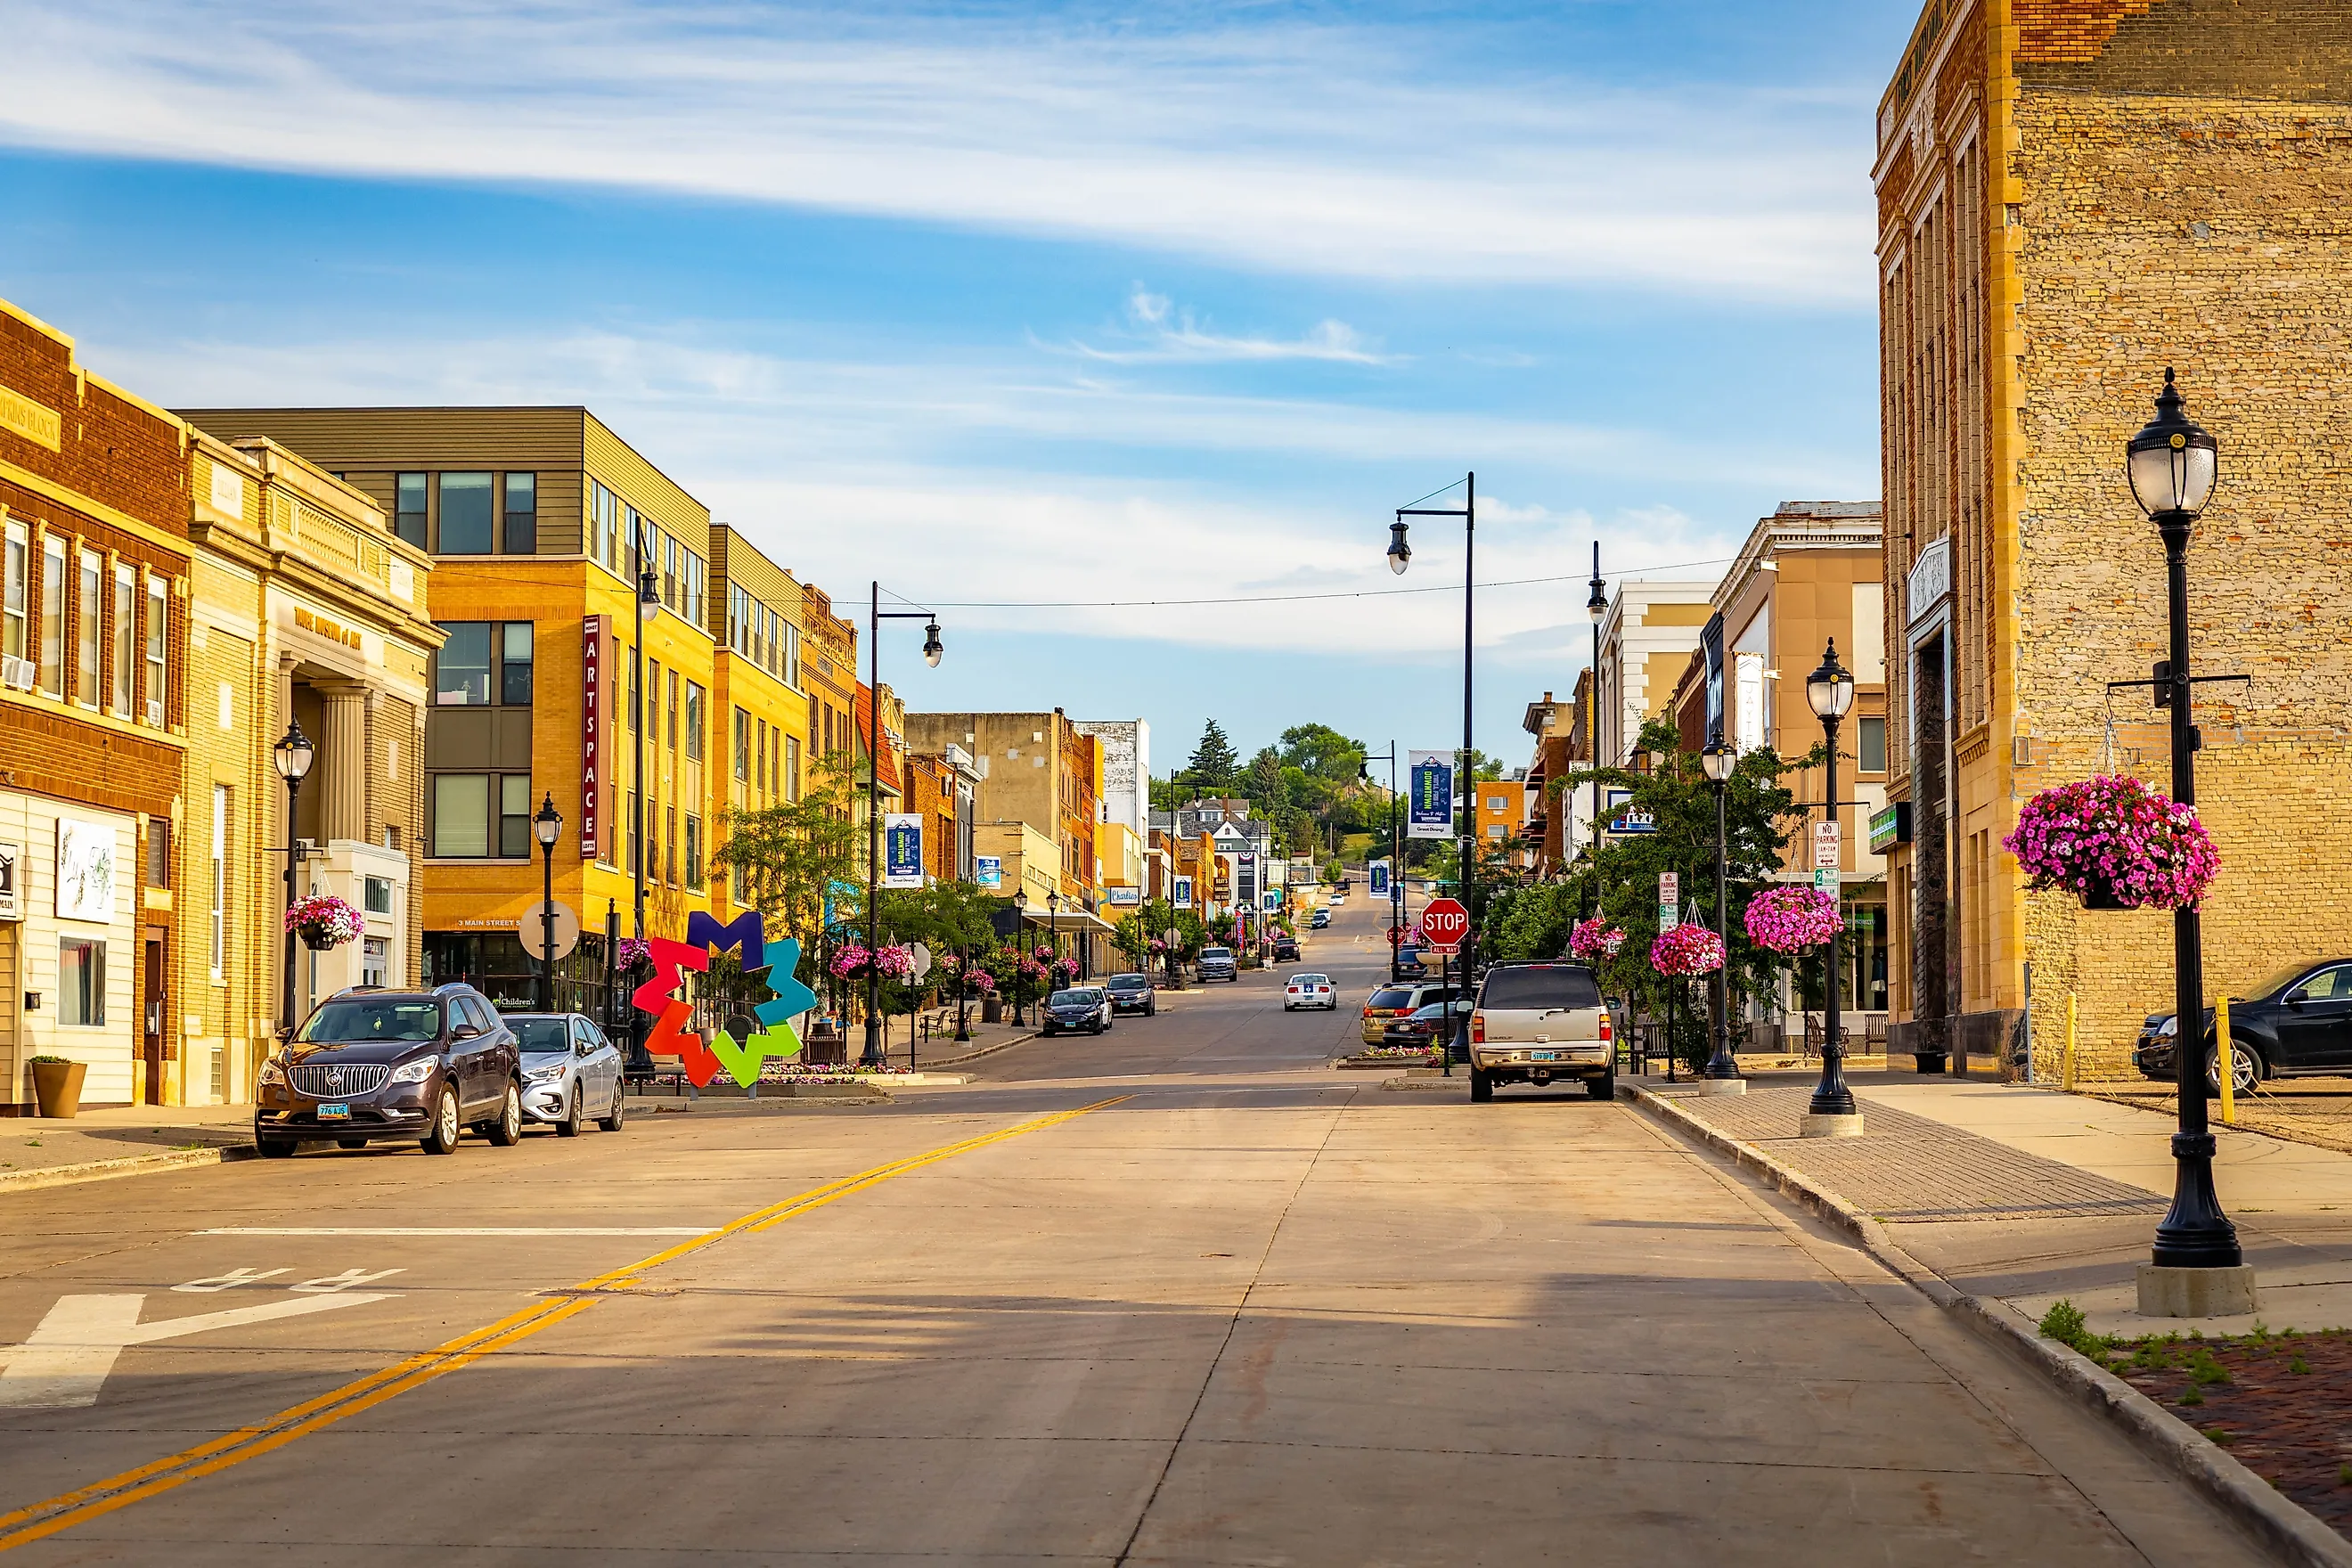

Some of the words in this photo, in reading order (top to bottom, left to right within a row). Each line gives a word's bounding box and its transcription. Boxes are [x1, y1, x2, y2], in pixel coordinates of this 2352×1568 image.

[315, 616, 340, 642] MUSEUM
[349, 631, 362, 650] ART
[584, 641, 596, 833] ARTSPACE
[1424, 771, 1433, 810] DOWNTOWN
[1817, 836, 1838, 845] PARKING
[1822, 825, 1832, 834] NO
[897, 831, 905, 864] DOWNTOWN
[1817, 872, 1822, 884] 2
[1425, 913, 1465, 930] STOP
